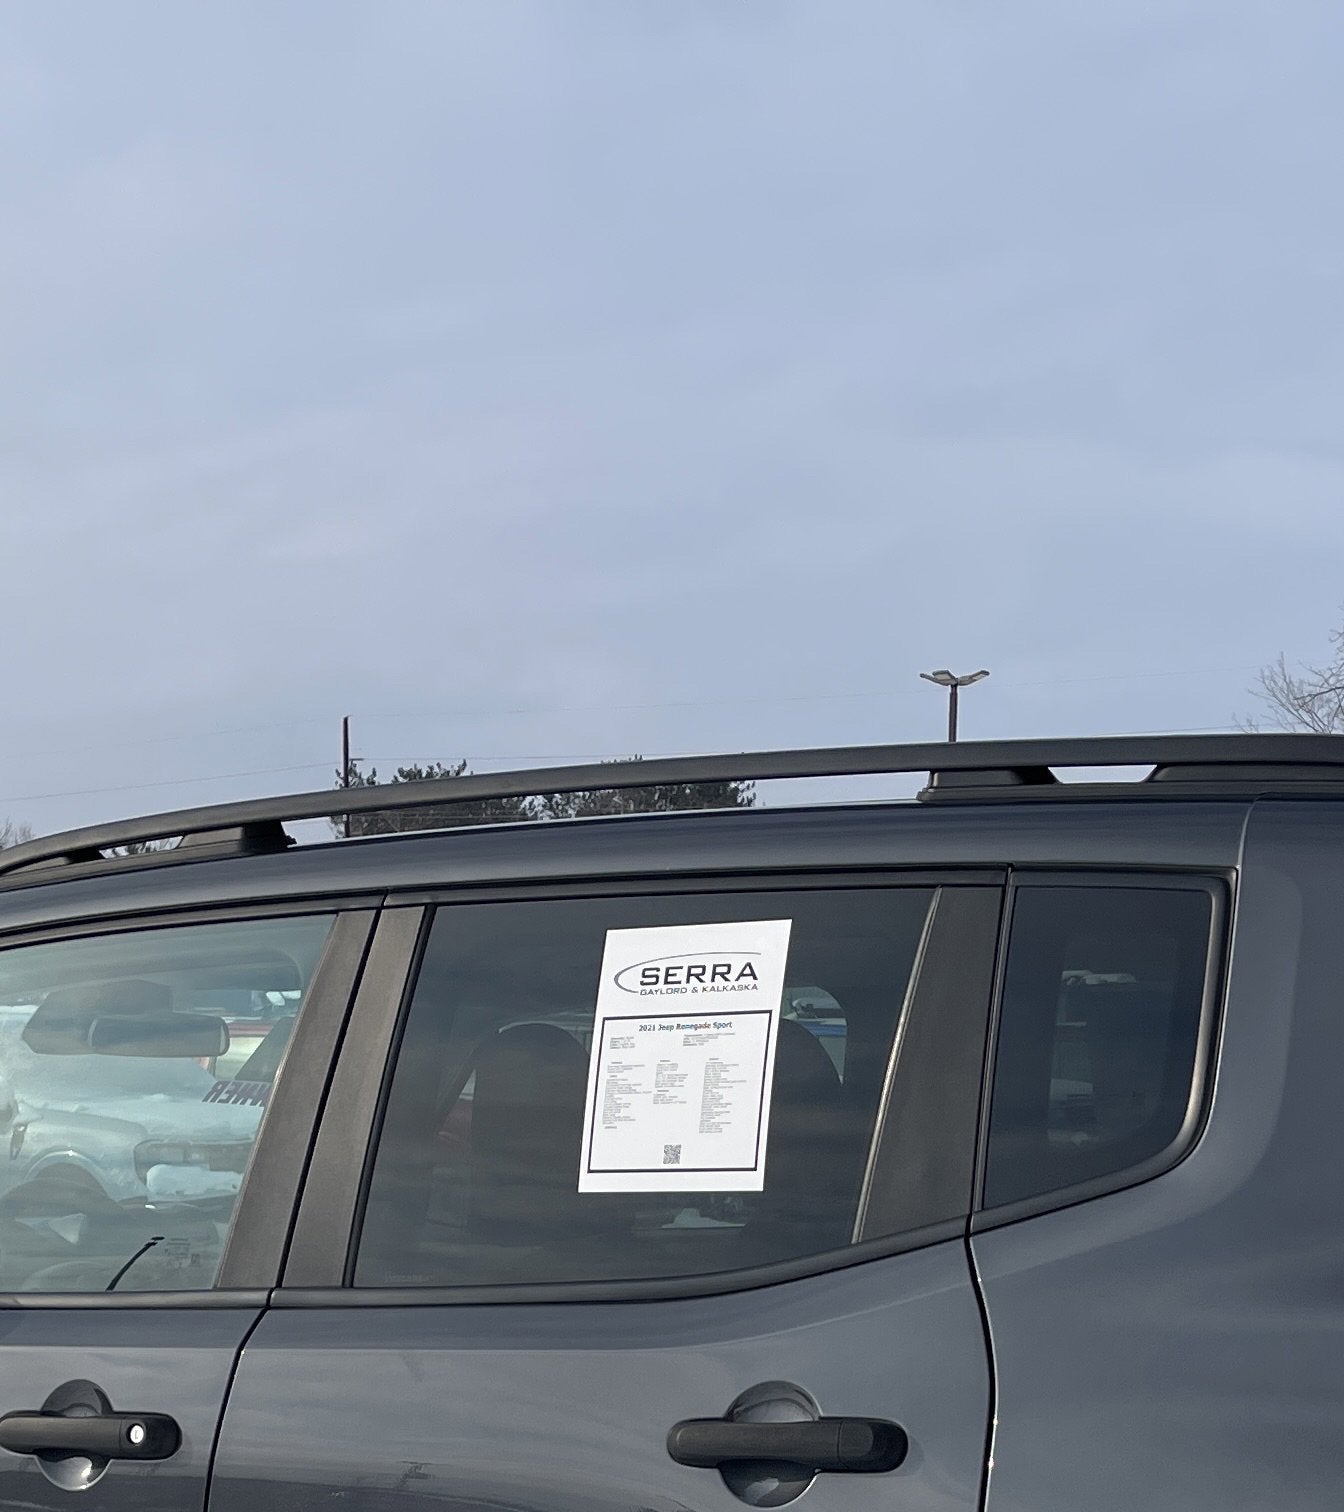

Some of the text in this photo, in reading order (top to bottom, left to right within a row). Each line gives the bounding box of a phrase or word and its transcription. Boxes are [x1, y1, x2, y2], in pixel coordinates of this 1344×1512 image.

[639, 961, 759, 986] SERRA
[639, 986, 688, 996] GAYLORD
[701, 983, 759, 993] KALKASKA
[638, 1021, 733, 1032] 2021 Jeep Renegade Sport
